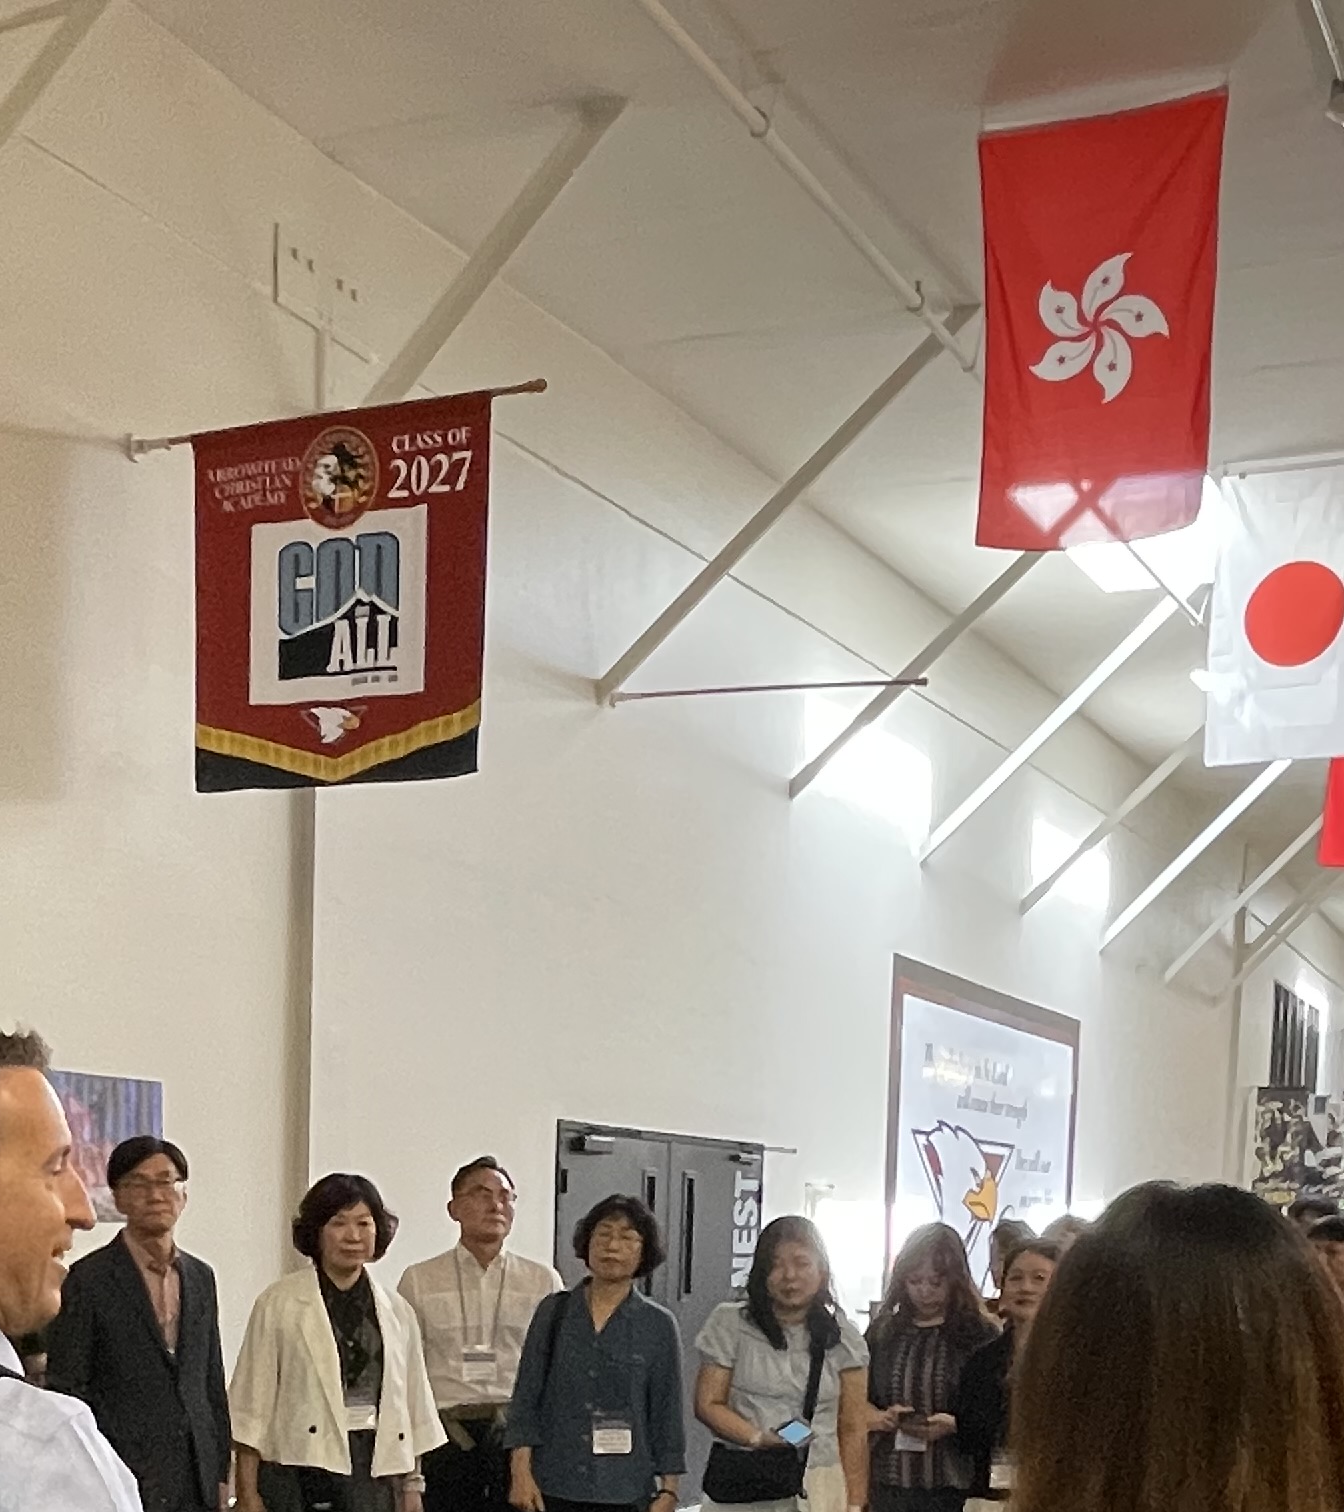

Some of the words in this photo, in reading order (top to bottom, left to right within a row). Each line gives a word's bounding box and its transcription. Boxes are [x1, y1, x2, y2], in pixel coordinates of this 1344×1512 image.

[391, 431, 443, 454] CLASS
[446, 426, 472, 446] OF
[386, 450, 473, 498] 2027
[730, 1170, 761, 1289] NEST
